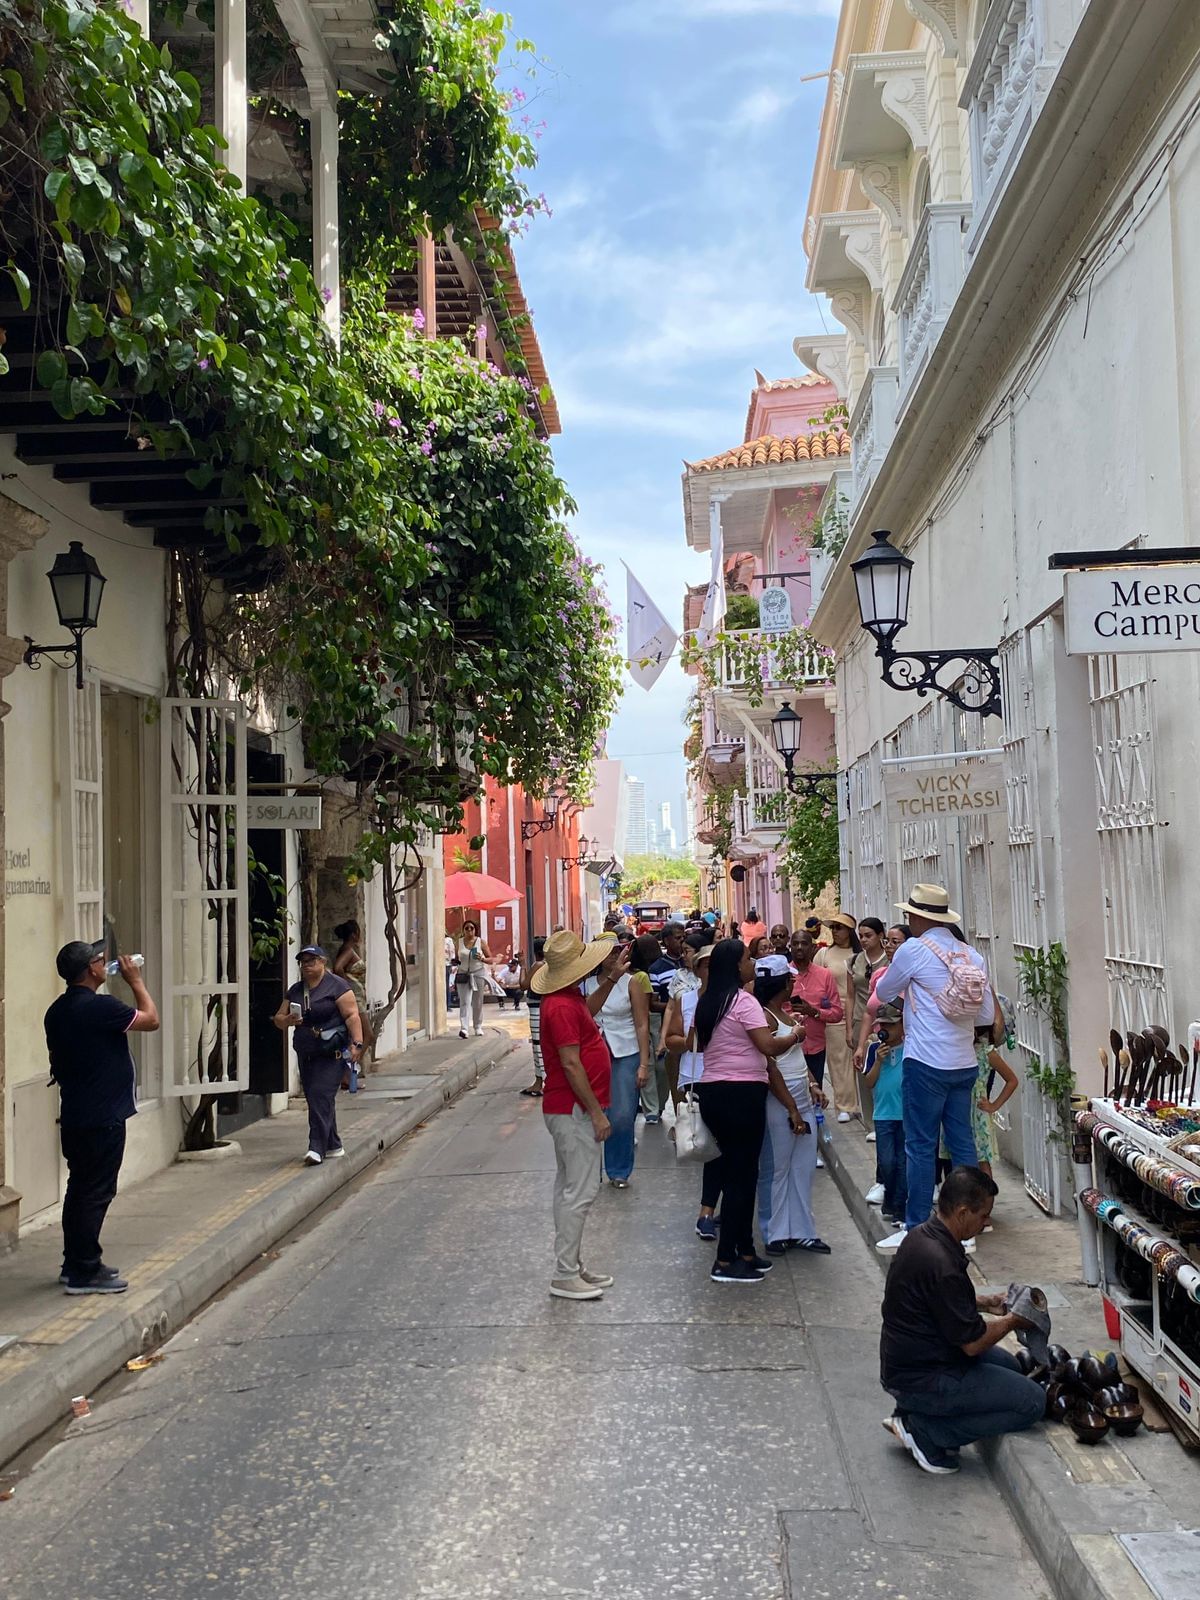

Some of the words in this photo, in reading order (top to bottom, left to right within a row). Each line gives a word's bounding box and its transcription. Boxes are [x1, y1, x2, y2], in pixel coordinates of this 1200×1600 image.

[916, 774, 971, 793] VICKY
[256, 804, 314, 820] SOLARI
[897, 790, 1000, 816] TCHERASSI
[5, 848, 30, 869] Hotel
[5, 877, 51, 900] guamarina
